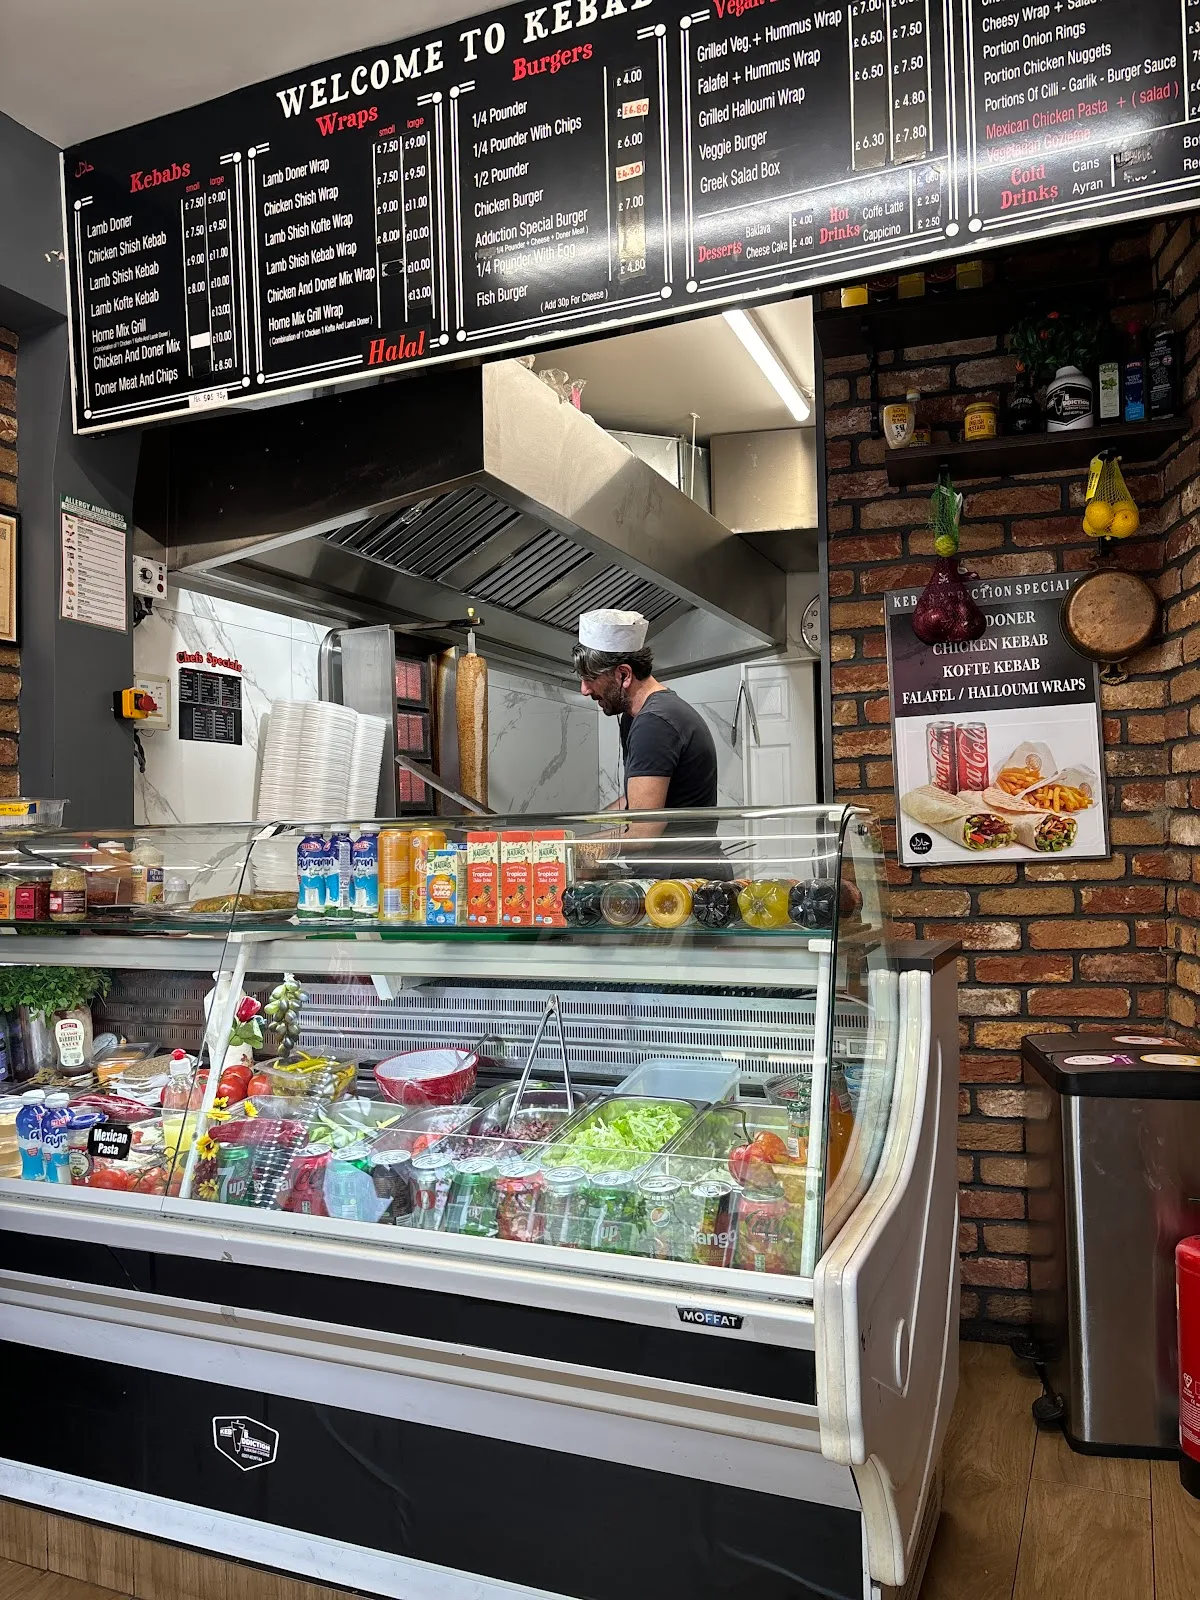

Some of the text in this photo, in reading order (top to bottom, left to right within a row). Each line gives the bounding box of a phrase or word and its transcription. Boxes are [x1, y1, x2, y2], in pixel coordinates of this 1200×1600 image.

[982, 4, 1050, 32] Cheesy Wrap
[697, 10, 842, 62] Grilled Veg. Hummus Wrap
[983, 22, 1086, 60] Portion Onion Rings
[276, 40, 444, 119] WELCOME
[459, 22, 505, 63] TO
[512, 43, 593, 81] Burgers
[698, 49, 820, 95] Falafel Hummus Wrap
[984, 43, 1112, 86] Portion Chicken Nuggets
[985, 56, 1176, 113] Portions Of Cilli Garlik Burger Sauce
[315, 106, 378, 136] Wraps
[472, 101, 528, 128] 1/4 Pounder
[698, 87, 805, 128] Grilled Halloumi Wrap
[985, 87, 1171, 139] Mexican Chicken Pasta salad
[379, 124, 396, 136] small
[407, 117, 424, 128] large
[472, 116, 582, 158] 1/4 Pounder With Chips
[698, 130, 768, 160] Veggie Burger
[130, 163, 190, 192] Kebabs
[262, 158, 330, 188] Lamb Doner Wrap
[474, 162, 530, 188] 1/2 Pounder
[700, 162, 780, 194] Greek Salad Box
[1071, 155, 1101, 173] Cans
[186, 182, 201, 192] small
[210, 176, 224, 185] large
[1072, 179, 1103, 196] Ayran
[264, 186, 339, 217] Chicken Shish Wrap
[474, 189, 544, 218] Chicken Burger
[862, 201, 904, 220] Coffe Latte
[1000, 184, 1058, 210] Drinks
[87, 215, 133, 238] Lamb Doner
[264, 213, 353, 246] Lamb Shish Kofte Wrap
[475, 208, 588, 248] Addiction Special Burger
[819, 224, 861, 246] Drinks
[862, 224, 901, 242] Cappicino
[88, 230, 167, 264] Chicken Shish Kebab
[266, 242, 357, 276] Lamb Shish Kebab Wrap
[746, 240, 788, 260] Cheese Cake
[89, 260, 160, 291] Lamb Shish Kebab
[267, 267, 376, 304] Chicken And Doner Mix Wrap
[90, 288, 160, 318] Lamb Kofte Kebab
[476, 282, 530, 307] Fish Burger
[92, 318, 146, 344] Home Mix Grill
[268, 304, 344, 332] Home Mix Grill Wrap
[94, 338, 181, 370] Chicken And Doner Mix
[368, 330, 425, 365] Halal
[94, 368, 178, 396] Doner Meat And Chips
[64, 496, 125, 522] ALLERGY AWARENESS
[986, 610, 1036, 627] DONER
[932, 633, 1048, 656] CHICKEN KEBAB
[176, 651, 243, 672] Chefs Specials
[942, 658, 1040, 678] KOFTE KEBAB
[902, 678, 1086, 704] FALAFEL HALLOUMI WRAPS
[93, 1128, 128, 1144] Mexican
[98, 1143, 119, 1155] Pasta
[682, 1310, 738, 1326] MOFFAT
